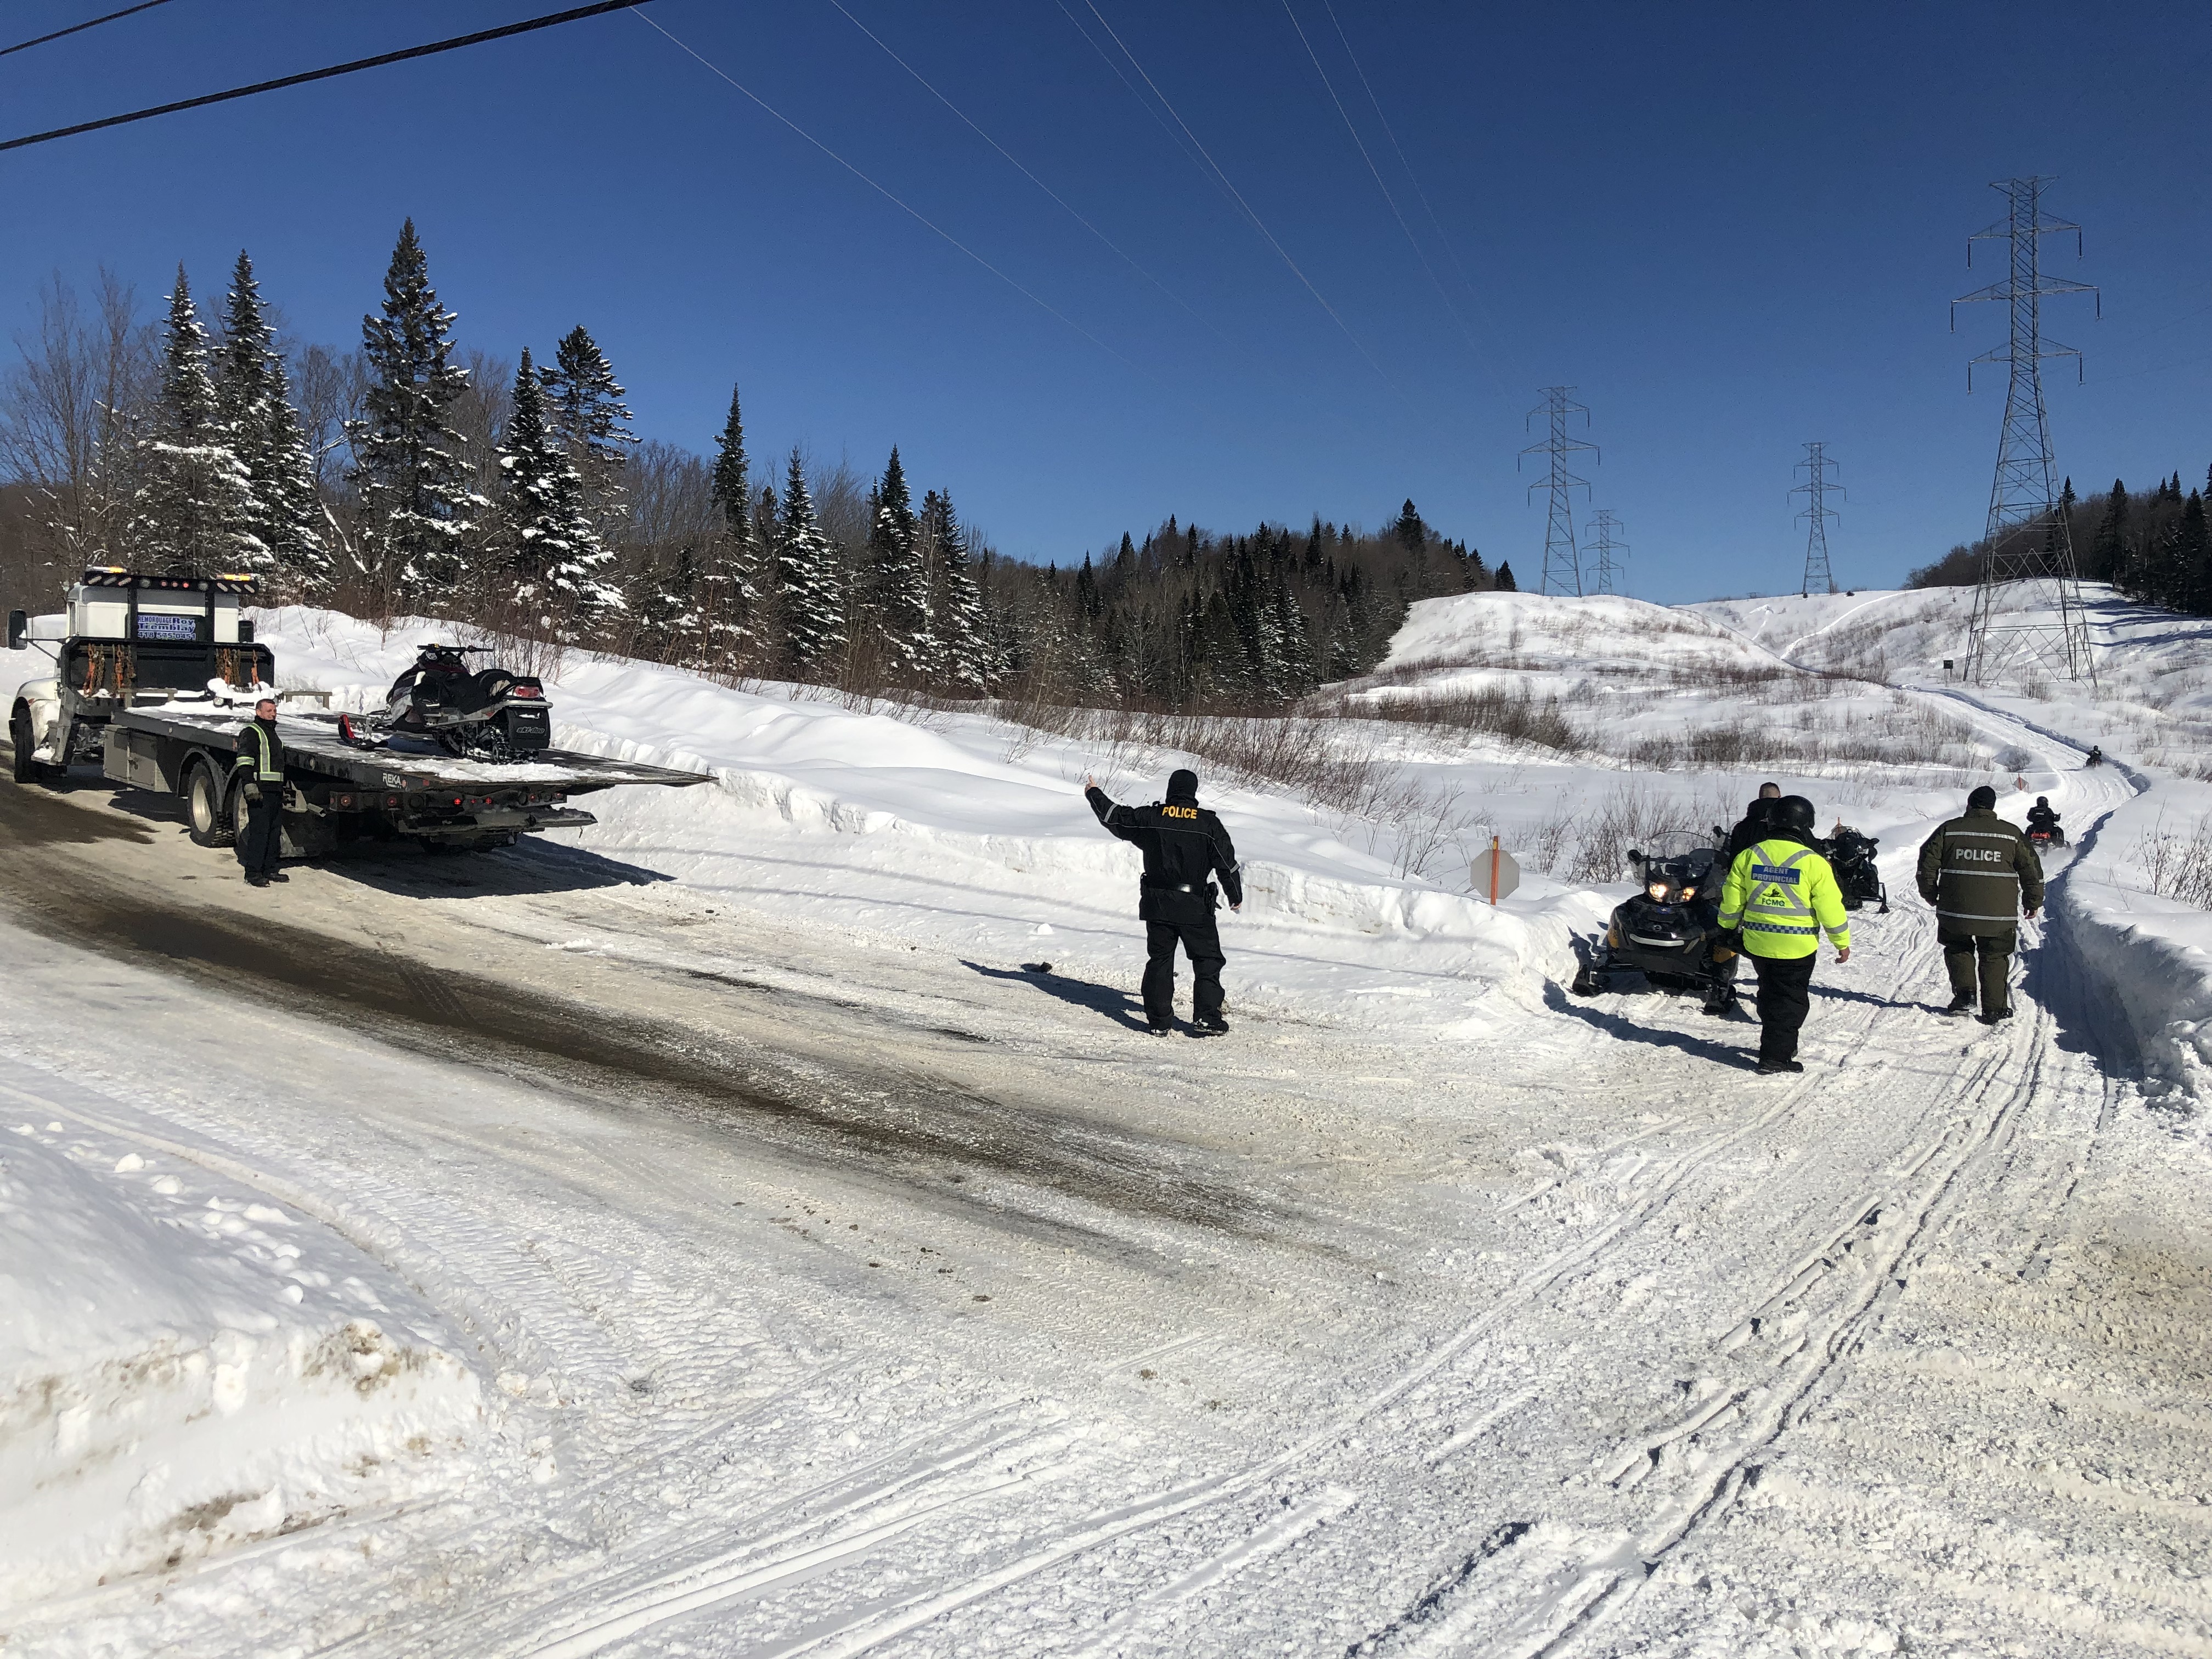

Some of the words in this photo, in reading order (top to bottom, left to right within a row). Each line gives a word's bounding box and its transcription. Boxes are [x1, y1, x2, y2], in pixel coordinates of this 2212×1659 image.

[138, 623, 195, 633] Tremblay
[382, 772, 401, 788] REKA
[1161, 805, 1198, 819] POLICE
[1955, 849, 2002, 862] POLICE
[1763, 866, 1789, 874] AGENT
[1752, 873, 1798, 884] PROVINCIAL
[1762, 898, 1785, 907] FCMQ
